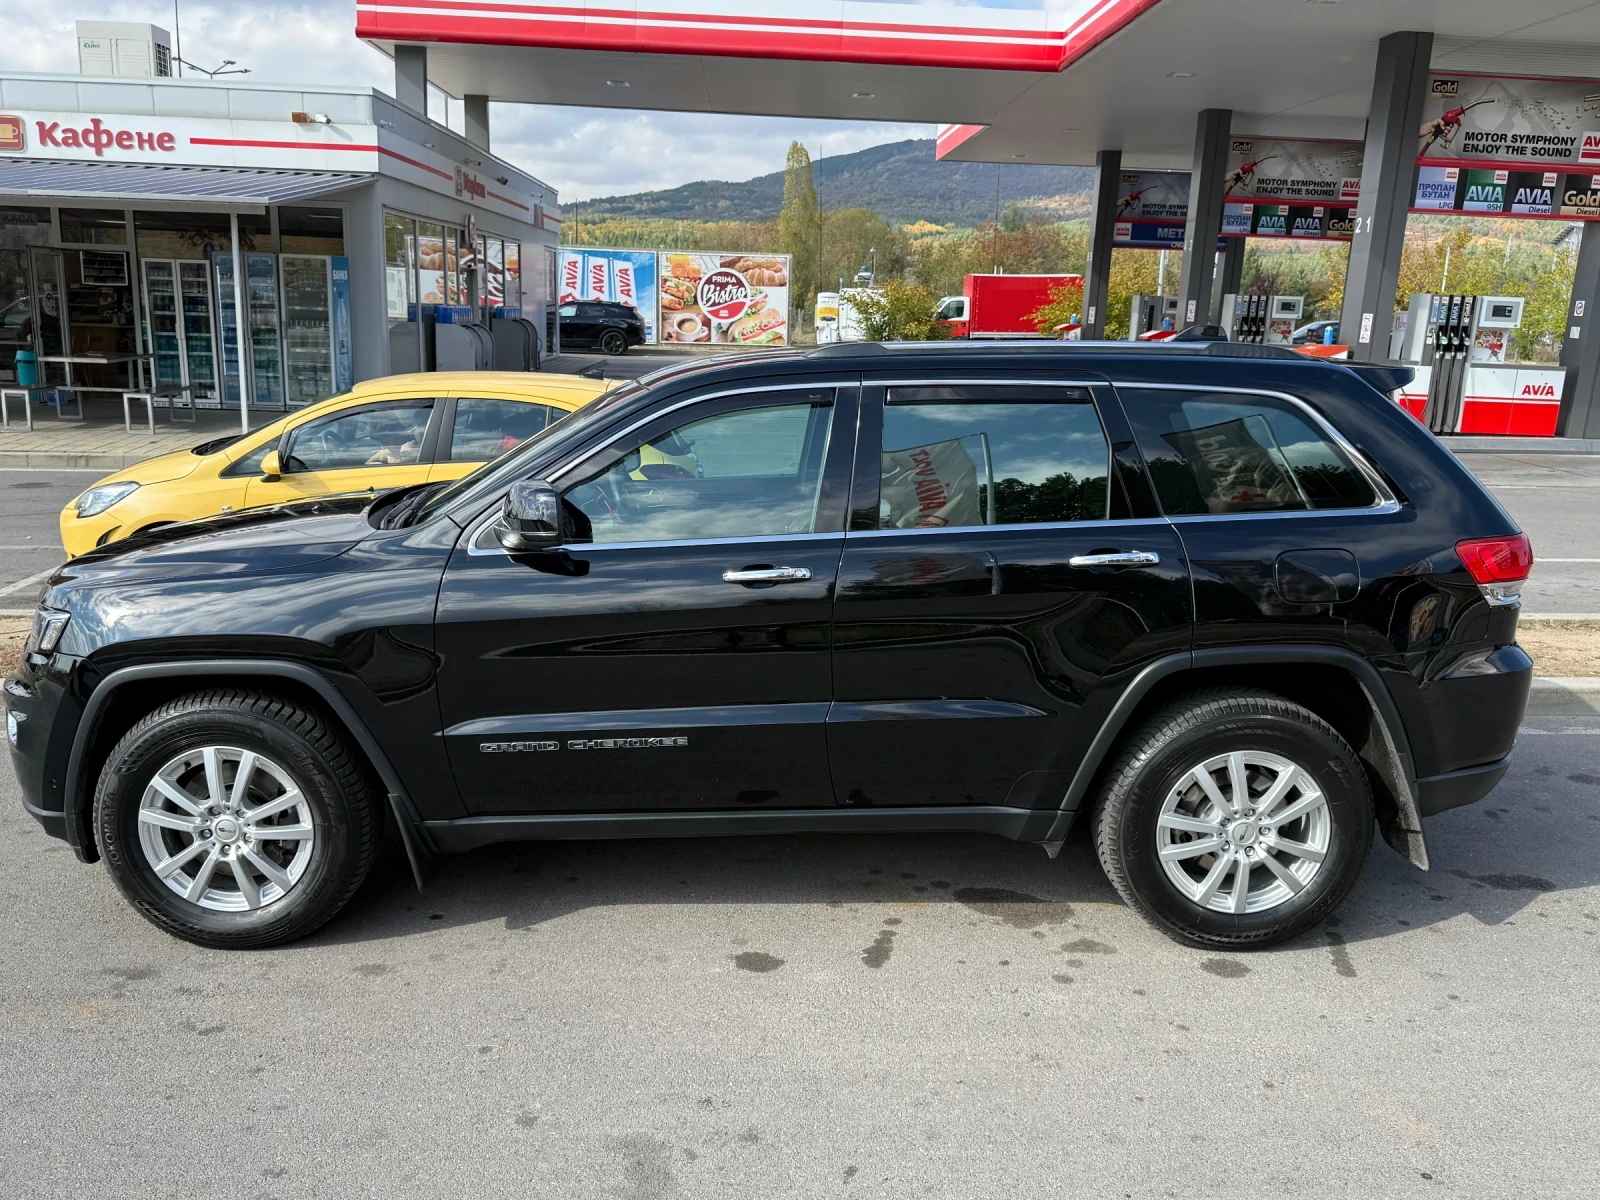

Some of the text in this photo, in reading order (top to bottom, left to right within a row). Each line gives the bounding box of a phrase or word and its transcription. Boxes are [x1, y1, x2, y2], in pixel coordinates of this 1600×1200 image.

[1433, 81, 1457, 94] Gold
[35, 118, 175, 157] Кафене
[1464, 131, 1577, 147] MOTOR SYMPHONY
[1233, 142, 1251, 151] Gold
[1462, 143, 1572, 158] ENJOY THE SOUND
[1257, 178, 1338, 189] MOTOR SYMPHONY
[1418, 183, 1455, 192] ПРОПАН
[1256, 186, 1335, 197] ENJOY THE SOUND
[1421, 191, 1450, 199] БУТАН
[1466, 185, 1503, 201] AVIA
[1514, 188, 1552, 204] AVIA
[1564, 190, 1600, 206] Gold
[1438, 201, 1453, 209] LPG
[1486, 203, 1502, 211] 95H
[1528, 206, 1550, 214] Diesel
[1576, 207, 1598, 216] Diesel
[3, 213, 35, 224] КАСА
[1226, 219, 1248, 227] БУТАН
[1259, 216, 1286, 228] AVIA
[1293, 217, 1320, 230] AVIA
[1355, 216, 1371, 234] 2 1
[564, 261, 578, 290] AVIA
[590, 264, 605, 294] AVIA
[712, 275, 737, 283] PRIMA
[616, 268, 632, 298] AVIA
[703, 284, 747, 307] Bistro
[1521, 383, 1555, 396] AVIA
[480, 736, 689, 752] GRAND CHEROKEE
